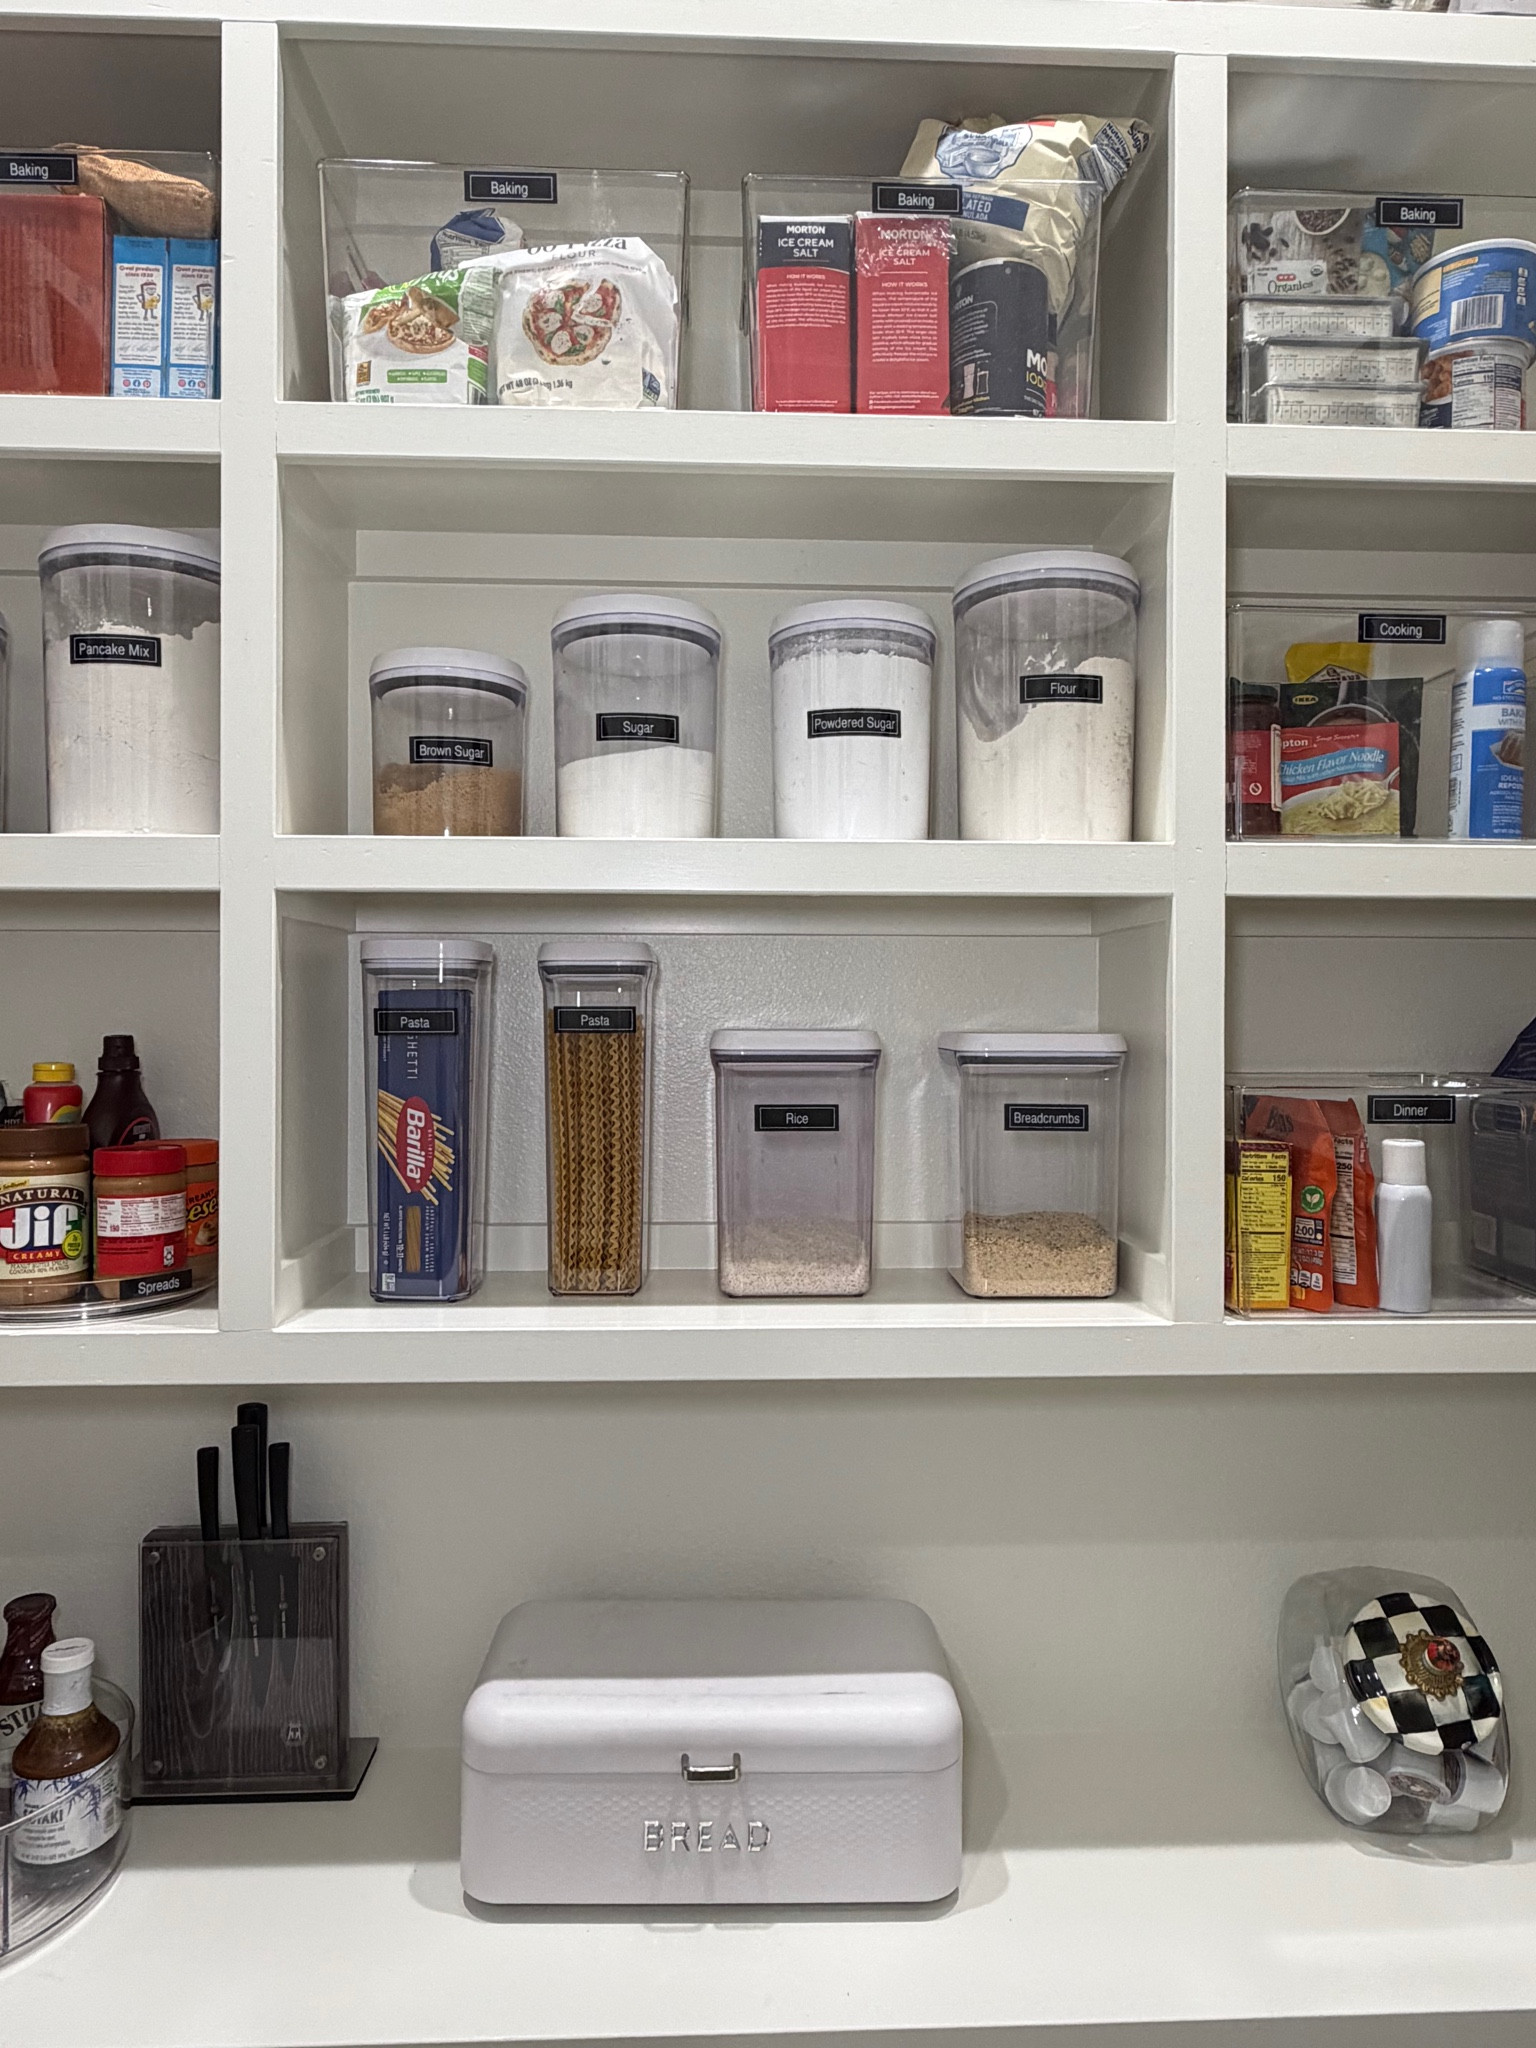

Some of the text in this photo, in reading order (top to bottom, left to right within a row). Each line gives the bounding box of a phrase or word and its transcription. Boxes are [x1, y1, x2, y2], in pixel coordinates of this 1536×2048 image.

[10, 163, 48, 179] Baking
[491, 181, 528, 197] Baking
[898, 193, 935, 210] Baking
[1400, 207, 1436, 224] Baking
[786, 225, 826, 234] MORTON
[880, 229, 930, 240] MORTON
[778, 238, 834, 248] ICE CREAM
[552, 250, 596, 260] FLOUR
[793, 248, 818, 258] SALT
[880, 248, 930, 257] ICE CREAM
[893, 258, 916, 266] SALT
[1268, 280, 1314, 294] Organics
[1026, 348, 1048, 377] MO
[1380, 623, 1422, 639] Cooking
[79, 642, 150, 658] Pancake Mix
[1050, 682, 1076, 696] Flour
[622, 721, 654, 736] Sugar
[814, 716, 896, 734] Powdered Sugar
[1282, 738, 1309, 750] pton
[419, 744, 484, 760] Brown Sugar
[1316, 754, 1348, 770] Flavor
[1349, 749, 1384, 763] Noodle
[400, 1017, 430, 1030] Pasta
[580, 1014, 610, 1026] Pasta
[1394, 1104, 1428, 1116] Dinner
[786, 1112, 809, 1124] Rice
[1013, 1111, 1081, 1124] Breadcrumbs
[406, 1107, 426, 1180] Barilla
[1273, 1174, 1286, 1182] 150
[0, 1188, 78, 1206] NATURAL
[0, 1204, 78, 1250] Jif
[13, 1250, 60, 1260] CREAMY
[138, 1277, 180, 1296] Spreads
[24, 1808, 64, 1824] SYAKI
[644, 1820, 772, 1852] BREAD
